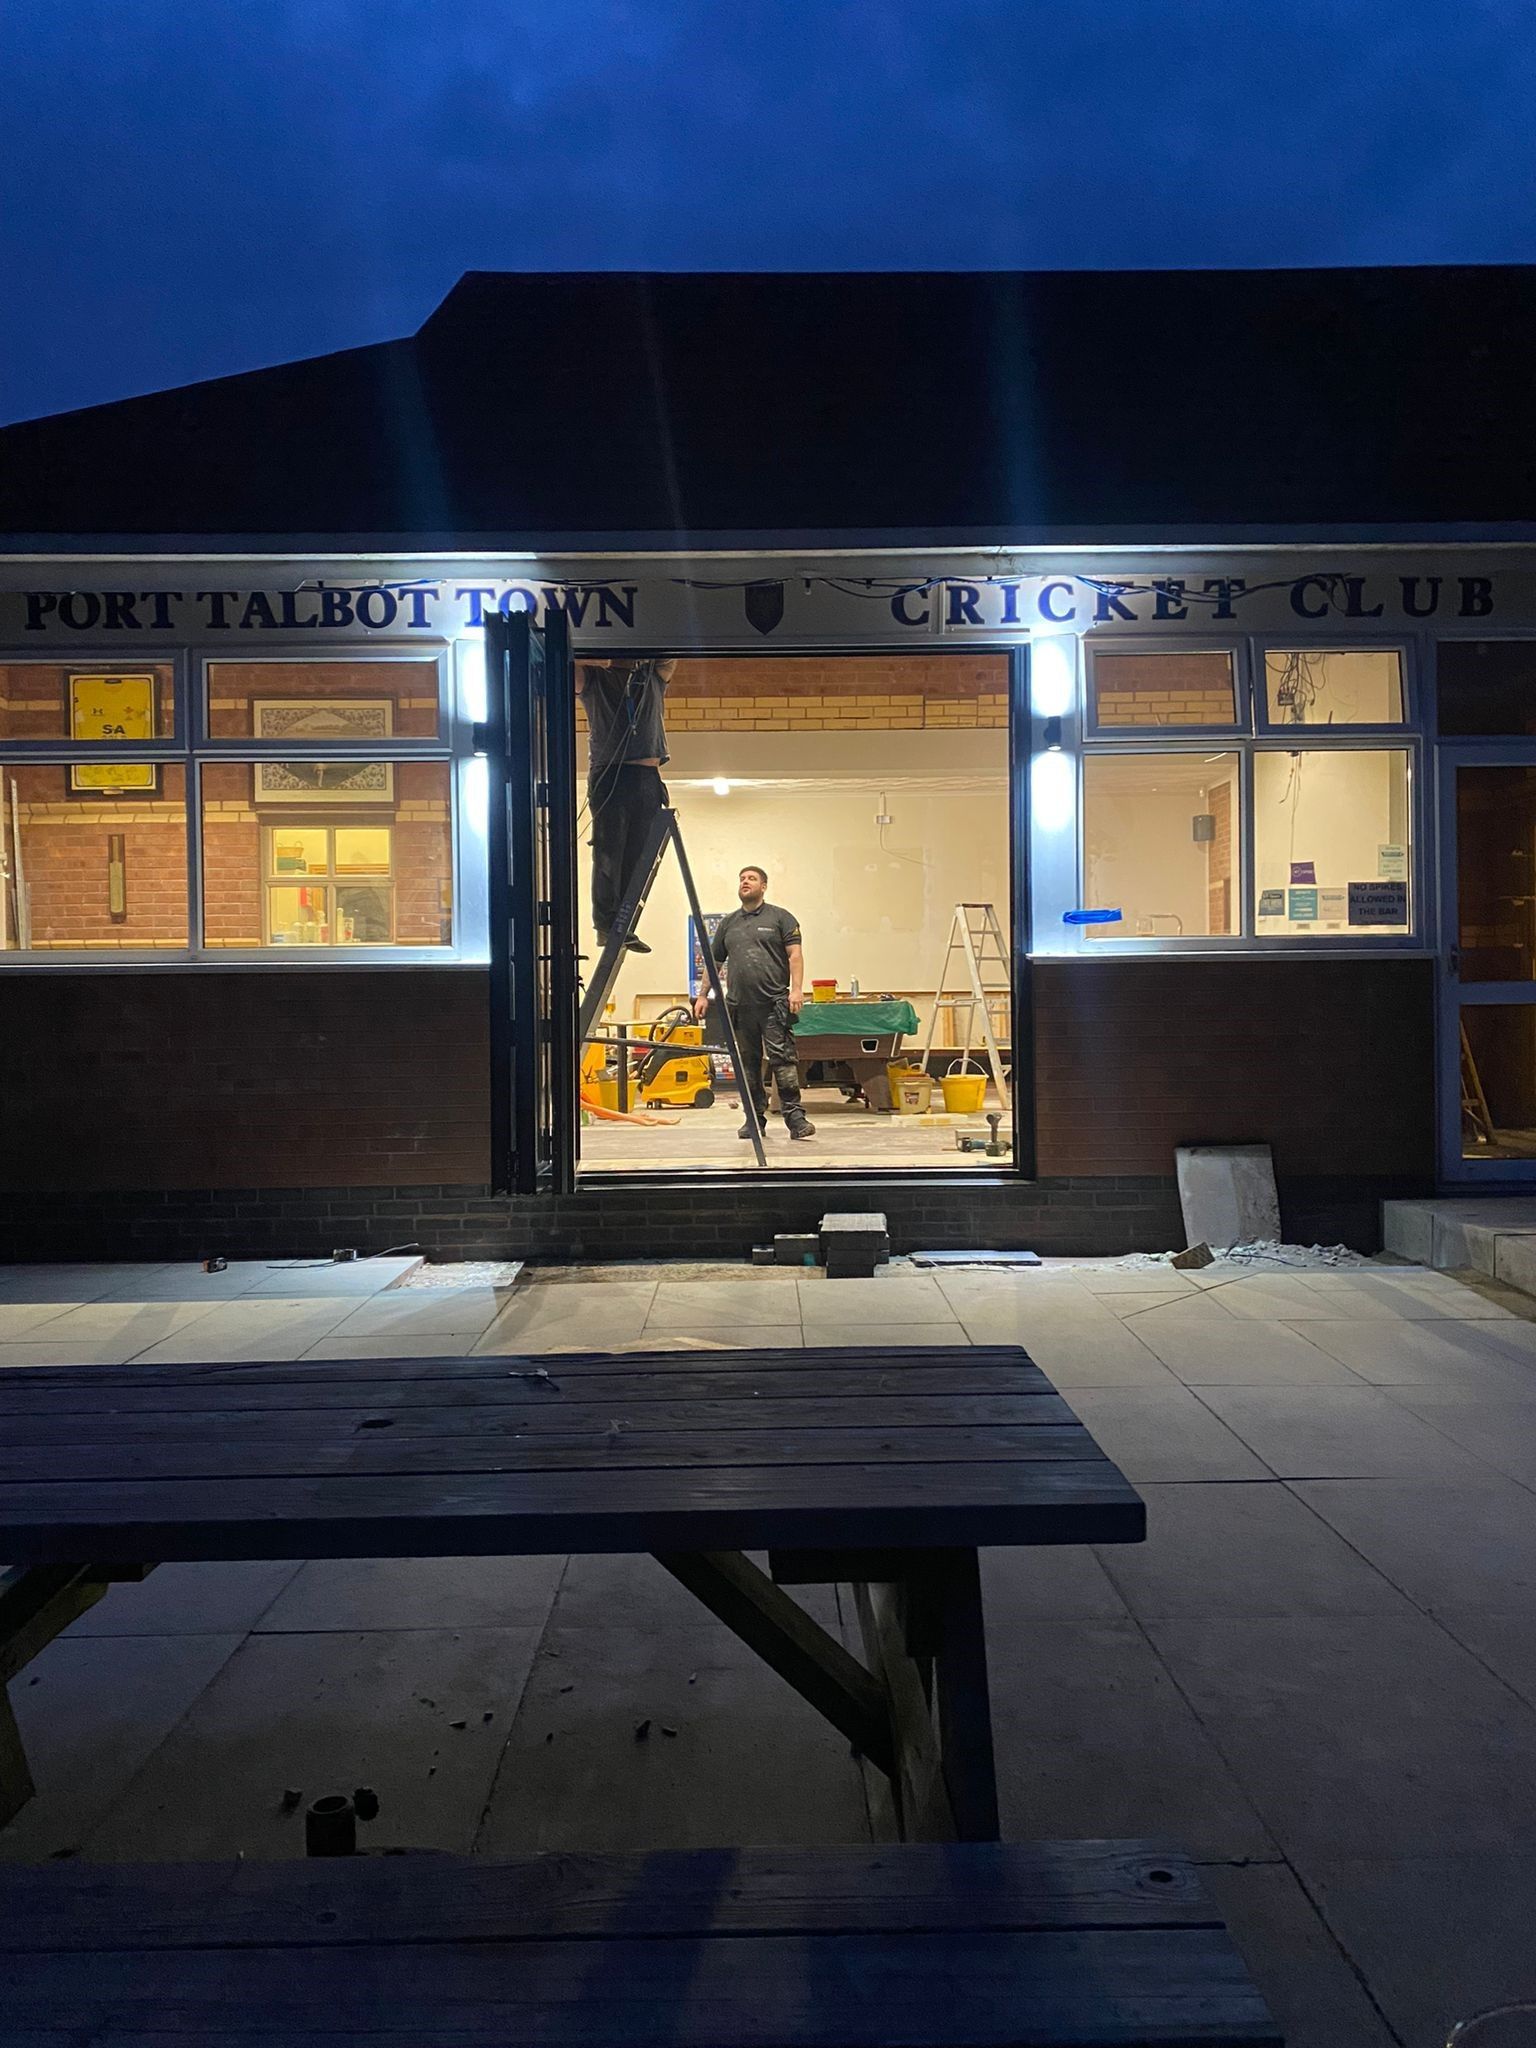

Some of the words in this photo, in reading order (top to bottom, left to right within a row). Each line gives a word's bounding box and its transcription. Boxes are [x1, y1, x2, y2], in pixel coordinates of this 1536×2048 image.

[24, 590, 183, 630] PORT
[196, 587, 438, 629] TALBOT
[456, 586, 638, 628] TOWN
[890, 579, 1246, 626] CRICKET
[1290, 576, 1493, 619] CLUB
